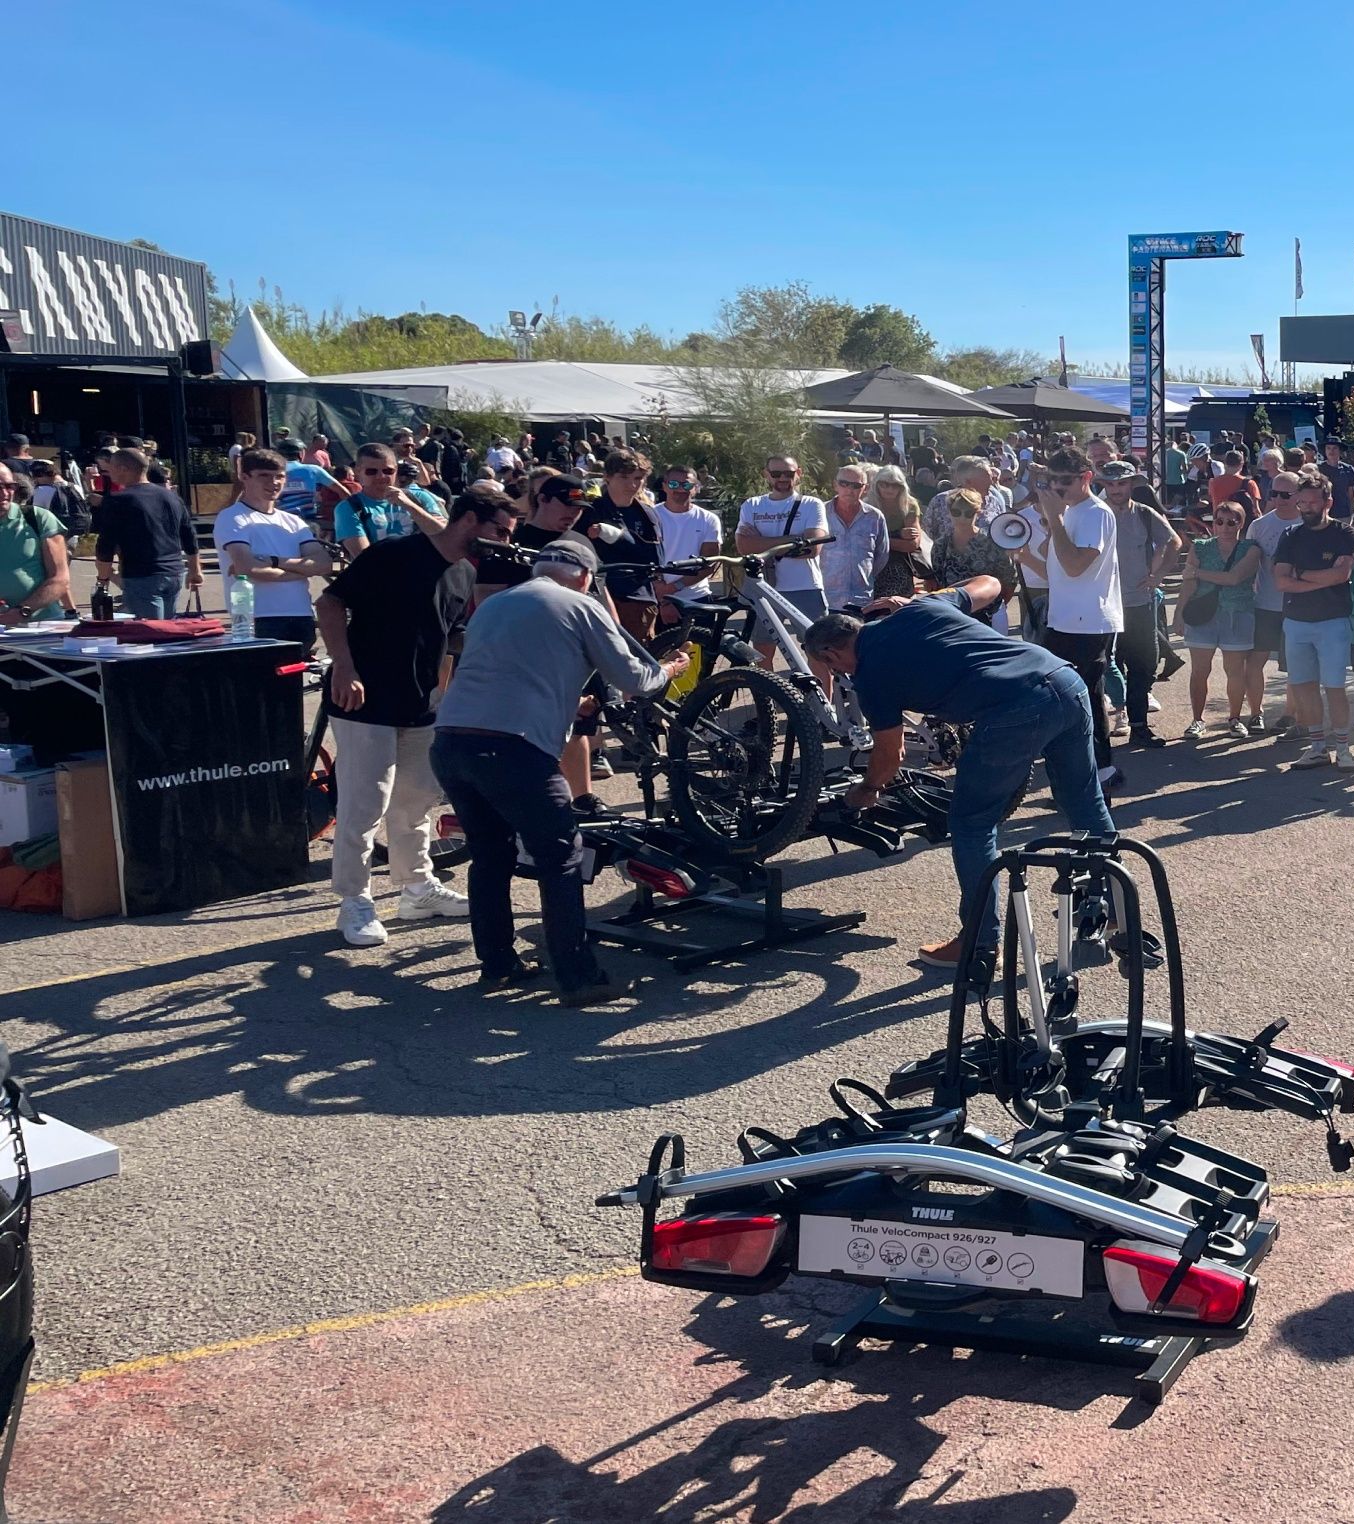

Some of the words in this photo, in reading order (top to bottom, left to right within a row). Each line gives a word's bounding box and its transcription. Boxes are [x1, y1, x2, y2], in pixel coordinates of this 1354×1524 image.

[137, 758, 290, 791] www.thule.com
[911, 1206, 955, 1221] THULE
[850, 1224, 879, 1235] Thule
[881, 1226, 950, 1241] VeloCompact
[952, 1233, 997, 1245] 926/927
